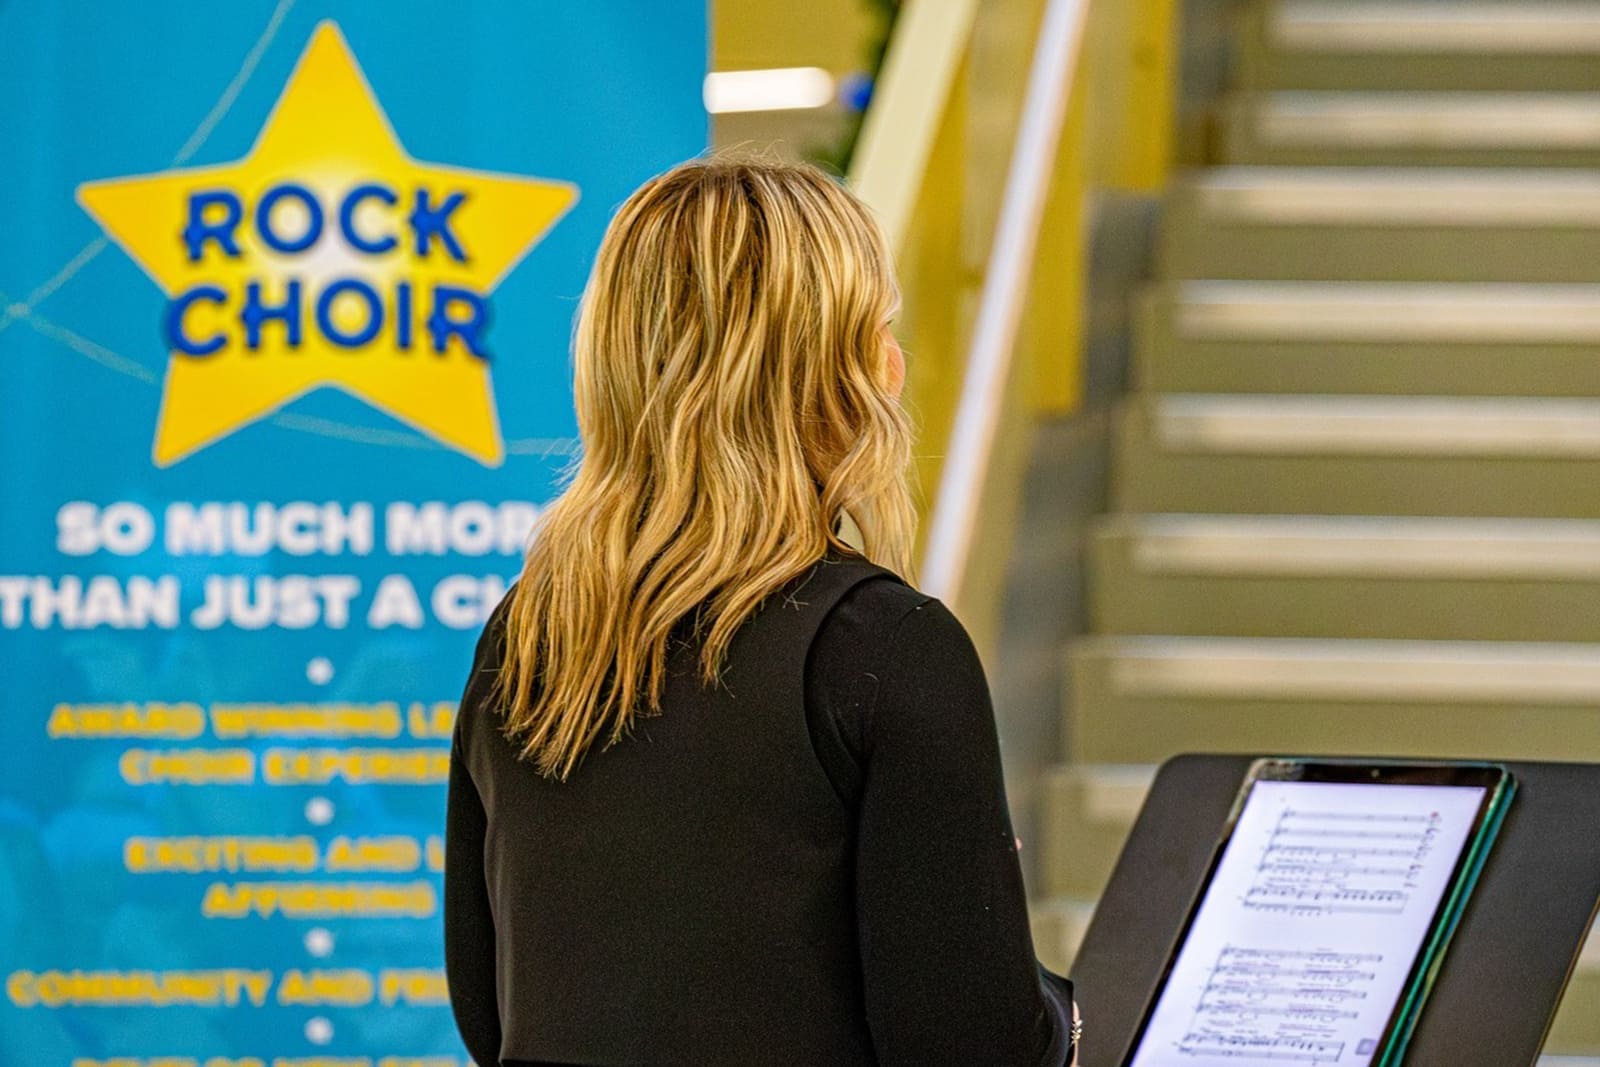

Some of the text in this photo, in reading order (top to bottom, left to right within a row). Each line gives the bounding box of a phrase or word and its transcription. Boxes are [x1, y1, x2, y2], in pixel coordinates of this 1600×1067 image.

[182, 184, 468, 263] ROCK
[163, 278, 494, 362] CHOIR
[57, 501, 540, 556] SO MUCH MOR
[0, 575, 180, 628] THAN
[192, 575, 360, 628] JUST
[368, 575, 424, 629] A
[48, 702, 206, 740] AWARD
[119, 748, 256, 785] CHOIR
[124, 836, 319, 873] EXCITING
[325, 836, 421, 873] AND
[7, 969, 272, 1007] COMMUNITY
[278, 969, 373, 1006] AND
